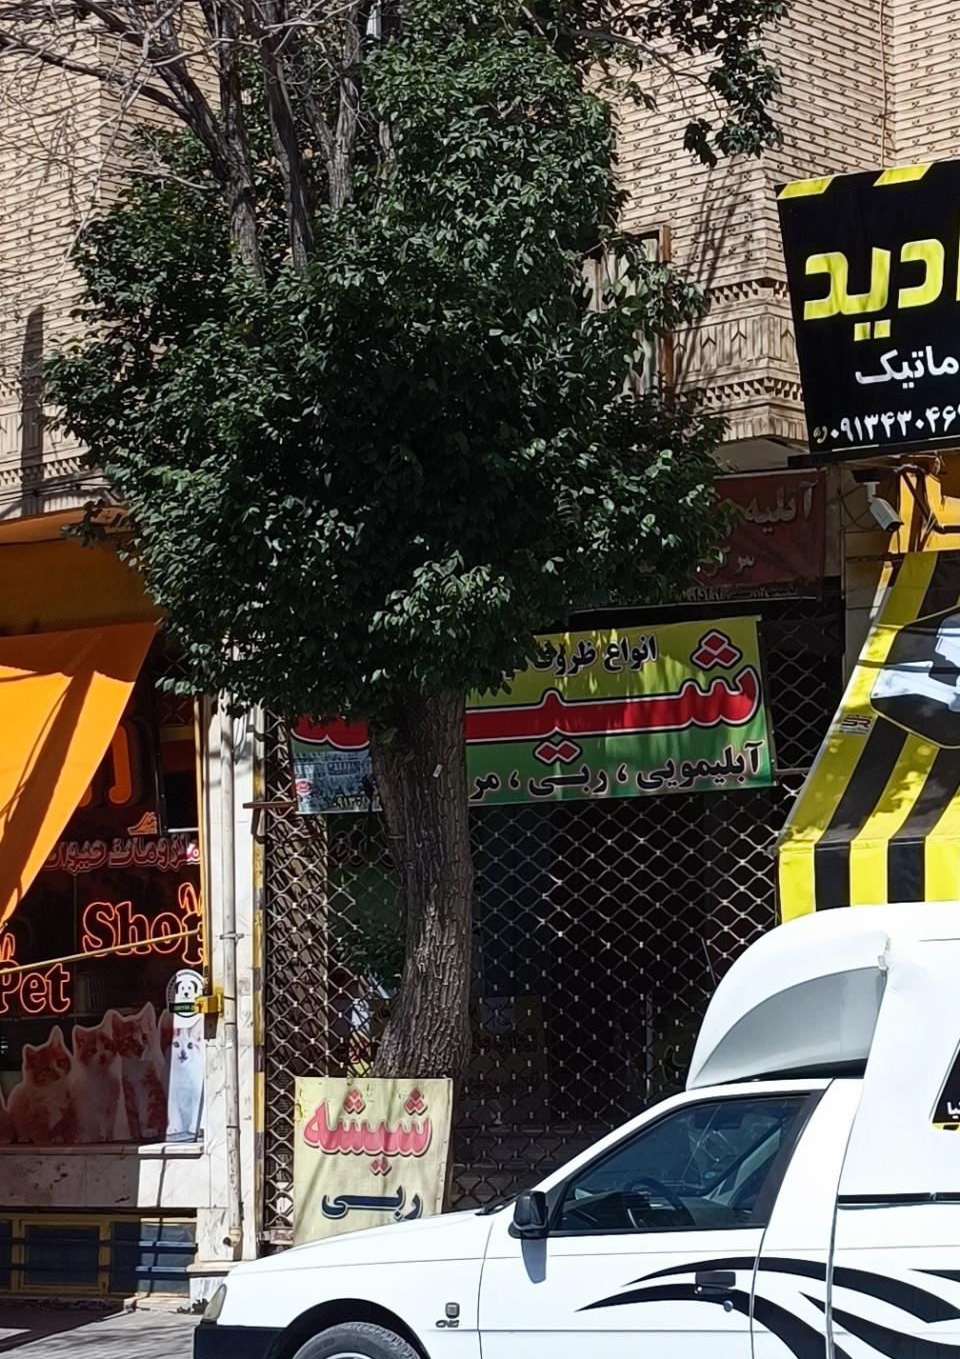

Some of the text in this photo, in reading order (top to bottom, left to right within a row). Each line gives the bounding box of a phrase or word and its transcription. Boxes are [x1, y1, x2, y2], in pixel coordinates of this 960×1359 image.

[603, 634, 658, 672] انواع
[528, 764, 608, 797] ربی
[636, 739, 765, 792] آبلیمویی
[303, 1086, 432, 1176] شیشه
[321, 1185, 423, 1221] ربی
